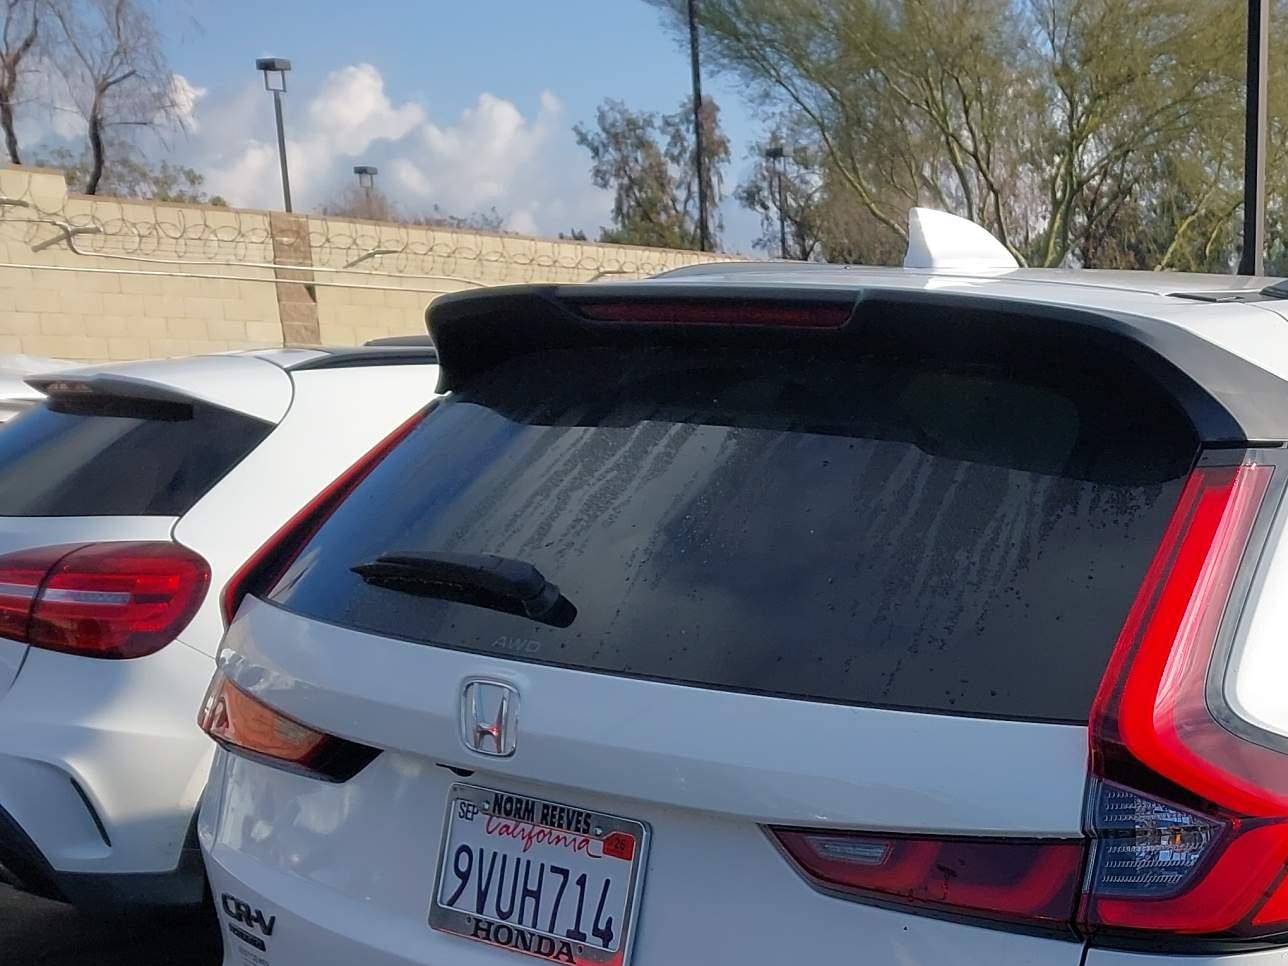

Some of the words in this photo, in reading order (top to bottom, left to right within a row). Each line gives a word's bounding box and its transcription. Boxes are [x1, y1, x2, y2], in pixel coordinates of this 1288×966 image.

[490, 635, 541, 653] AWD
[458, 801, 479, 821] SEP
[492, 793, 536, 822] NORM
[540, 803, 592, 835] REEVES
[485, 814, 603, 858] California
[221, 893, 276, 936] CR-V
[446, 844, 614, 949] 9VUH714
[471, 917, 577, 964] HONDA
